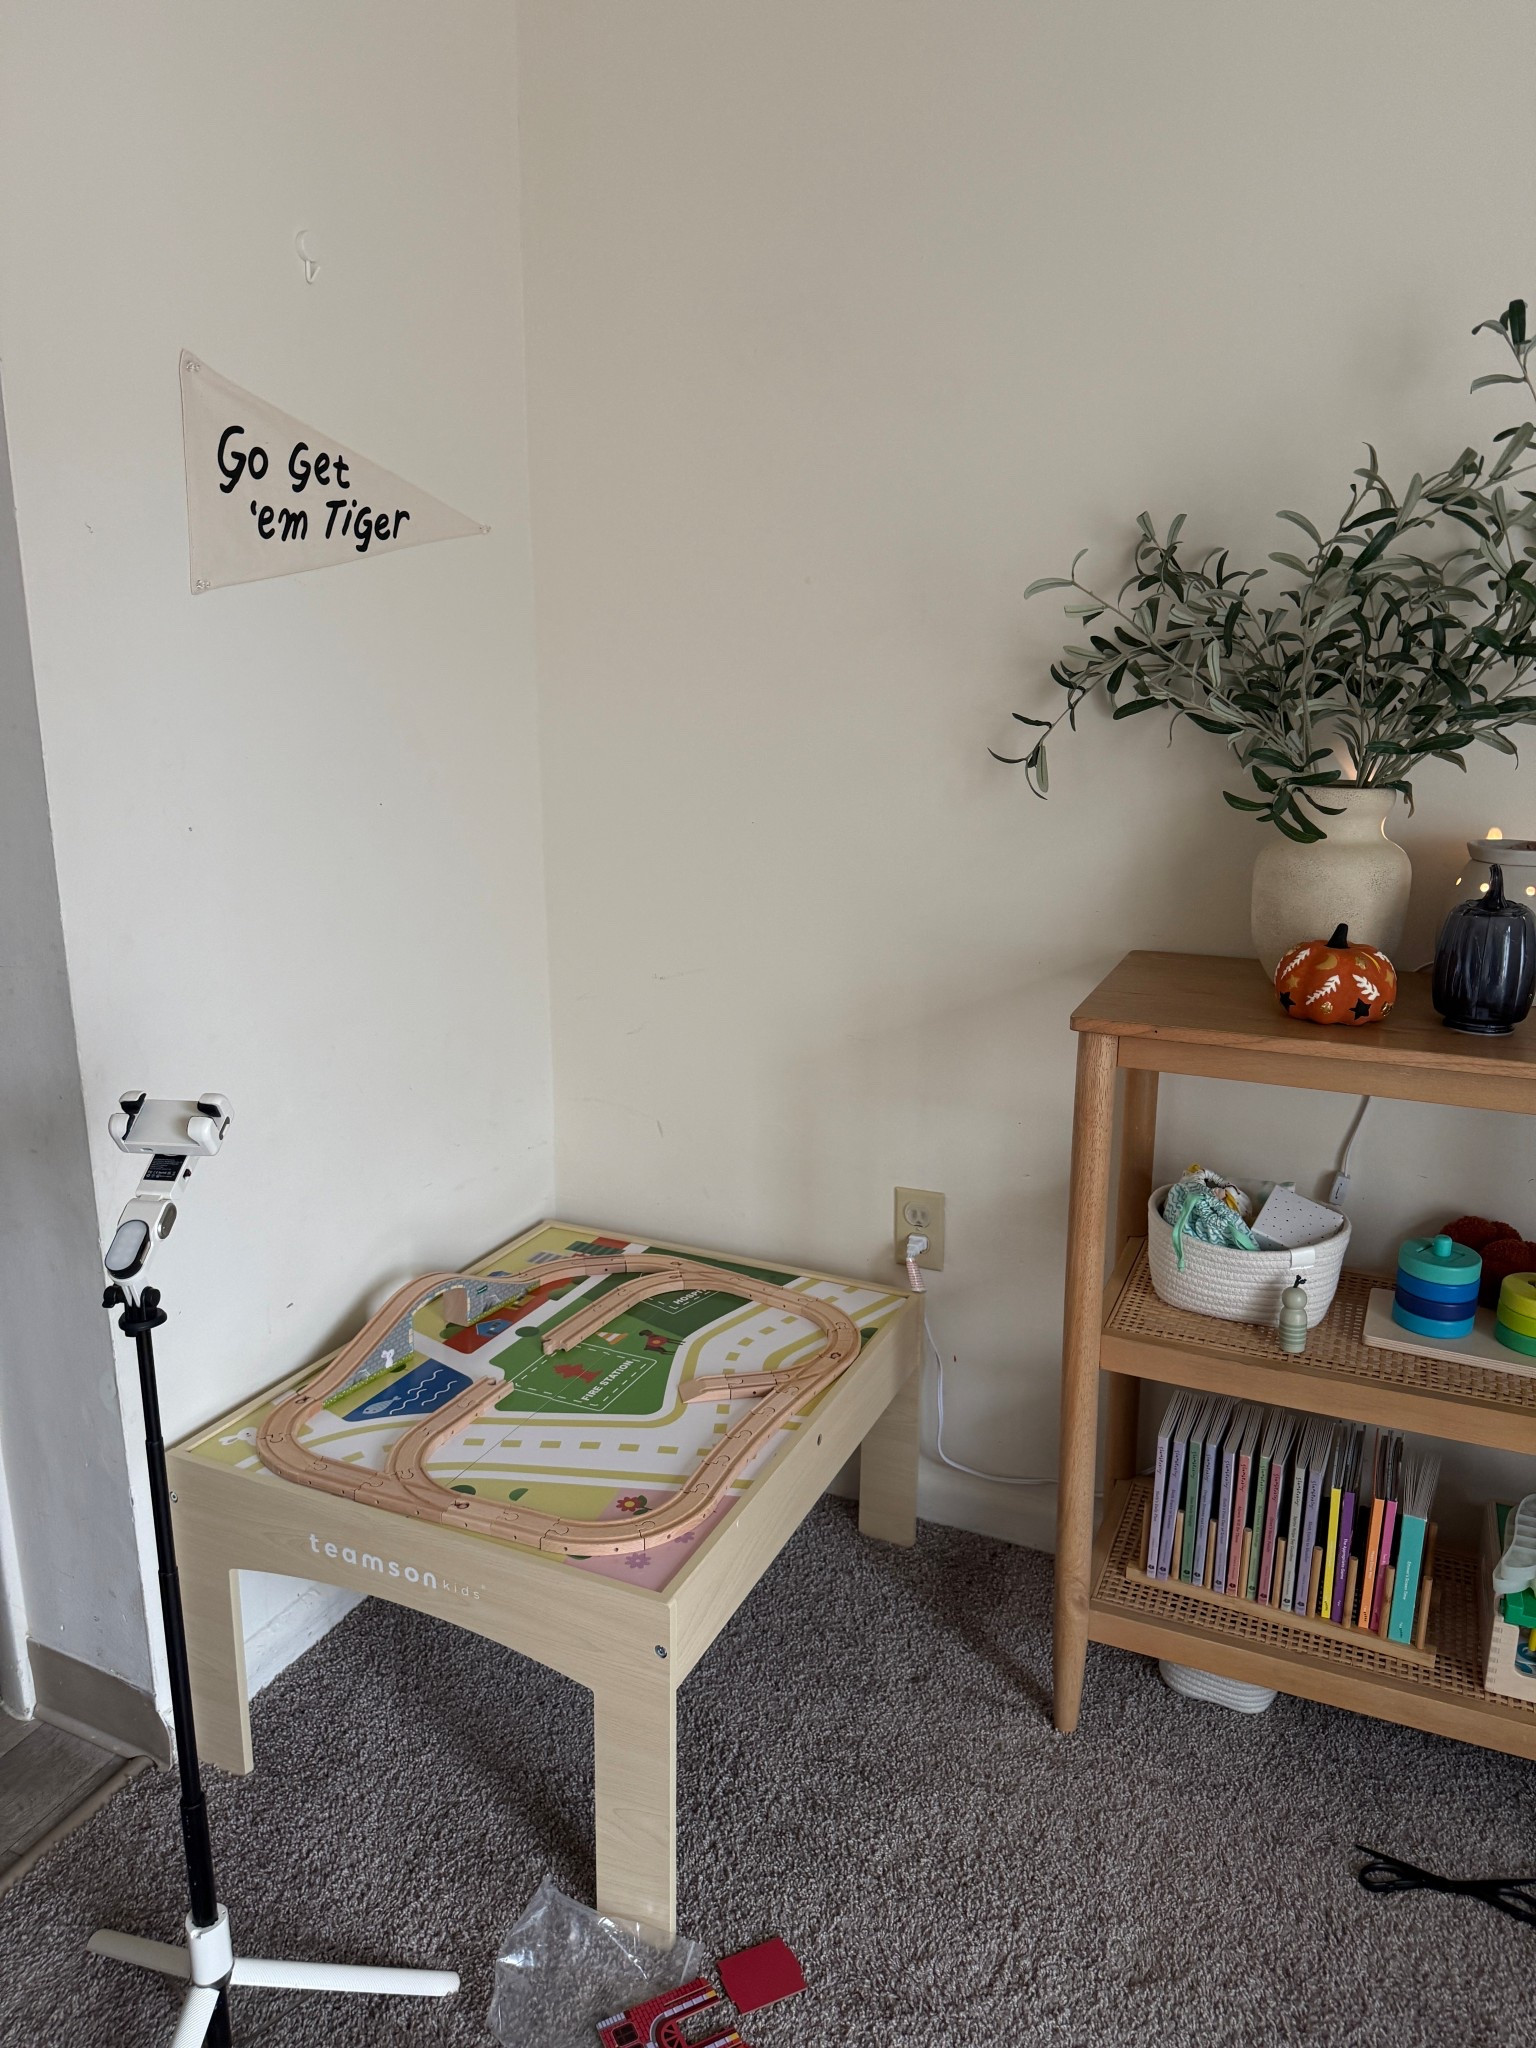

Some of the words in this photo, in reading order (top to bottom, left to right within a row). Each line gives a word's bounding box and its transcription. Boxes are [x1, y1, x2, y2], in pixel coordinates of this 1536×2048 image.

[218, 426, 268, 493] Go
[289, 442, 350, 492] Get
[326, 500, 410, 552] Tiger
[581, 1386, 602, 1402] FIRE
[600, 1359, 634, 1387] STATION
[309, 1533, 437, 1590] teamson
[442, 1579, 481, 1600] kids
